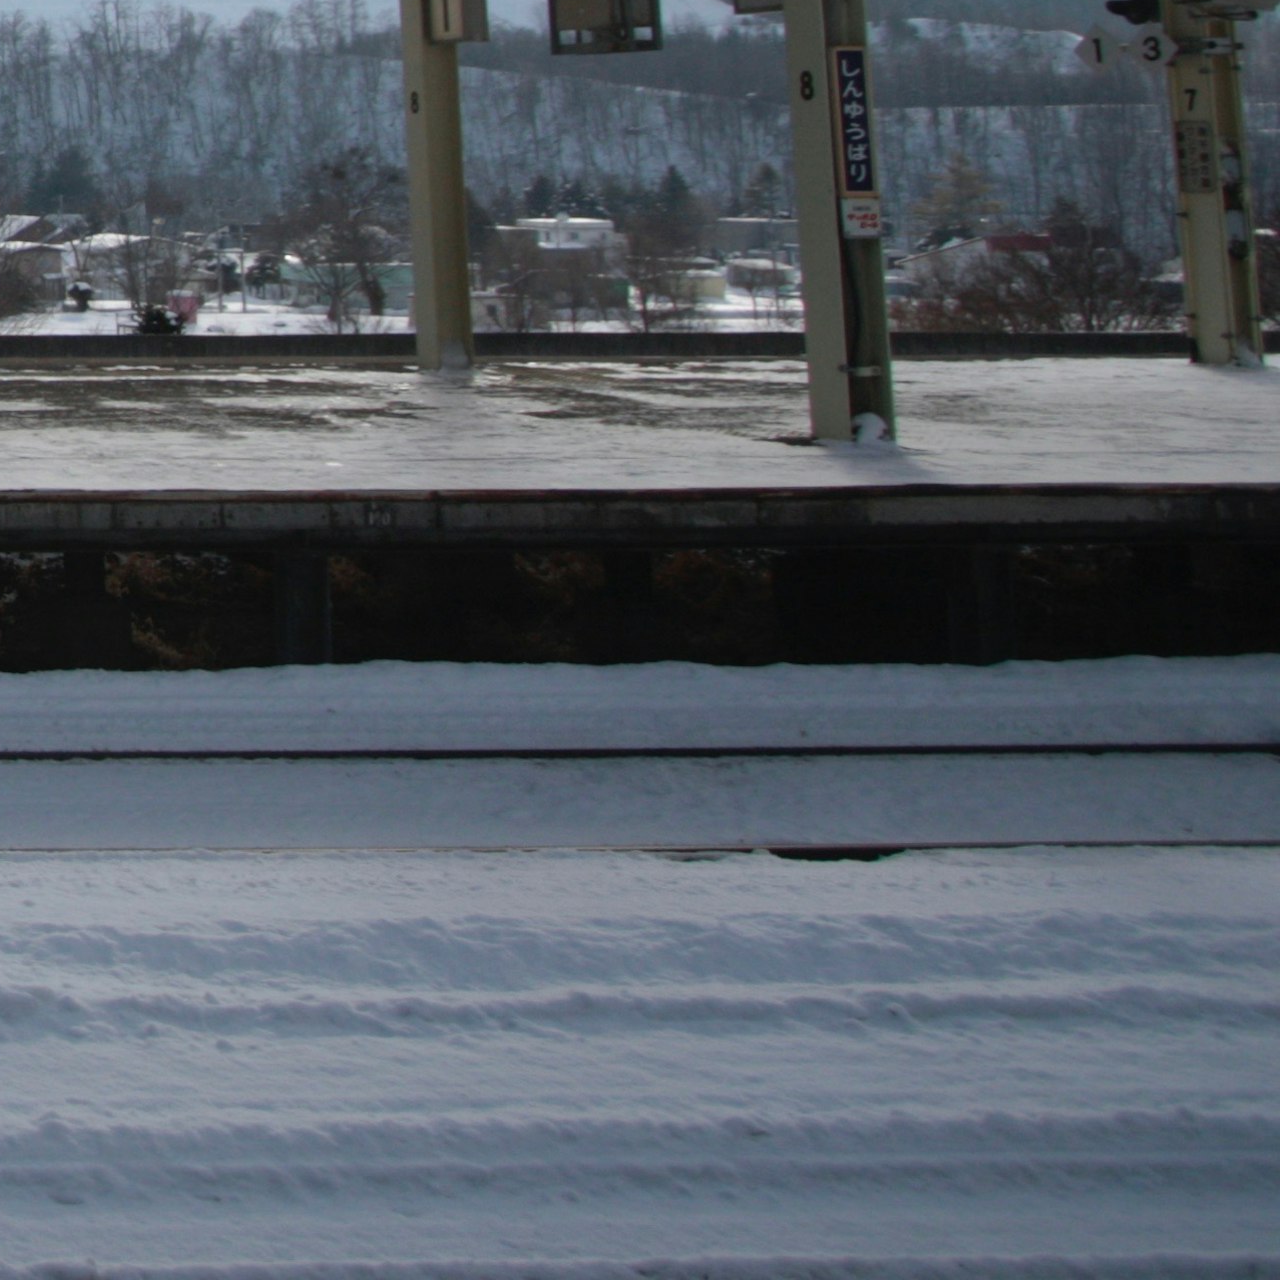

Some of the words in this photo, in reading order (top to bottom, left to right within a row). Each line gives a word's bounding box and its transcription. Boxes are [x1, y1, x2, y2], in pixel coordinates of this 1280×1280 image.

[1092, 38, 1102, 62] 1
[1143, 36, 1161, 61] 3
[800, 70, 814, 100] 8
[1184, 88, 1197, 111] 7
[841, 59, 868, 183] しんゆうばり
